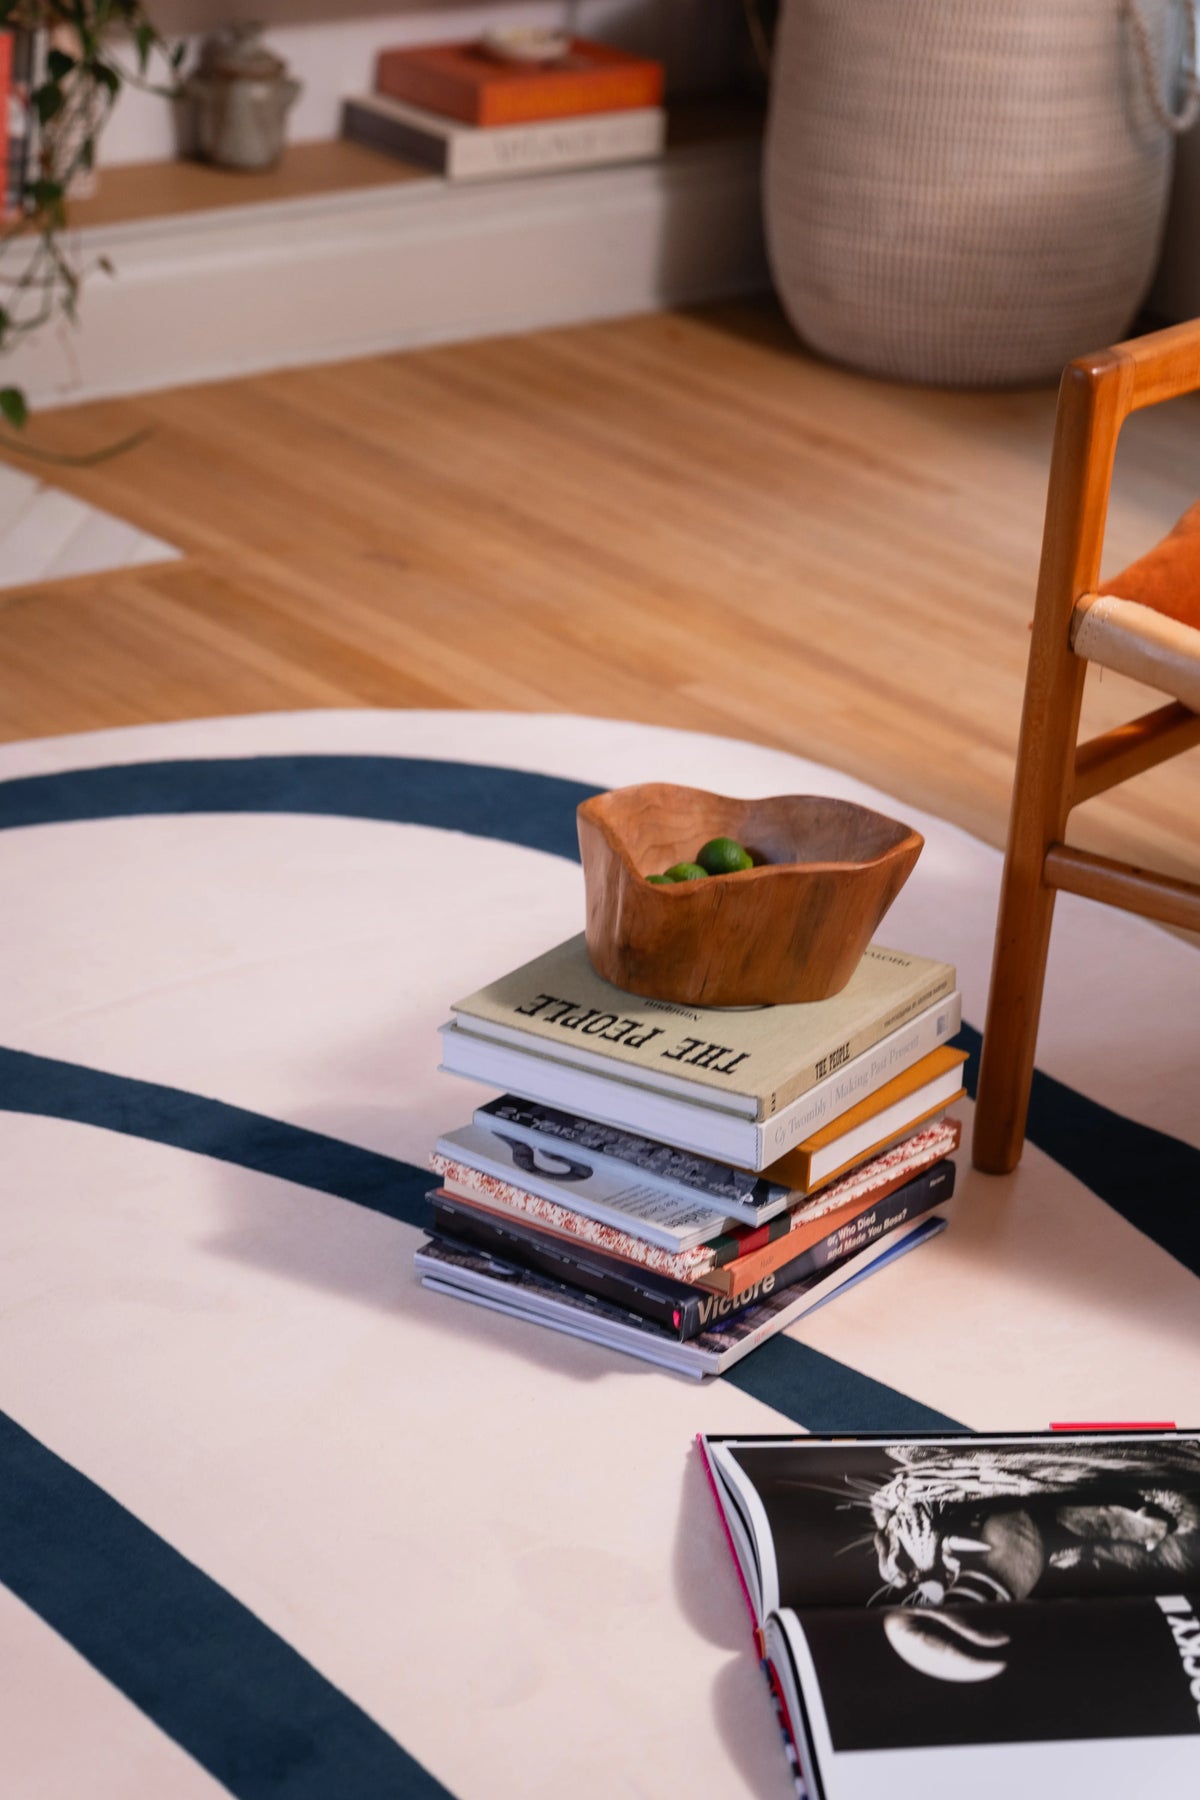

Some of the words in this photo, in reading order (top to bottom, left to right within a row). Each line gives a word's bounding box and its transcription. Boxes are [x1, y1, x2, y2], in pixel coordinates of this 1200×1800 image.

[515, 994, 665, 1048] PEOPLE
[661, 1036, 752, 1074] THE
[815, 1059, 827, 1080] THE
[829, 1042, 850, 1072] PEOPLE
[788, 1097, 827, 1134] Twombly
[835, 1071, 869, 1101] Making
[889, 1035, 920, 1065] Present
[826, 1246, 843, 1261] and
[843, 1232, 867, 1252] Made
[868, 1222, 882, 1238] You
[883, 1207, 908, 1230] Boss?
[837, 1224, 856, 1241] Who
[857, 1211, 876, 1232] Died
